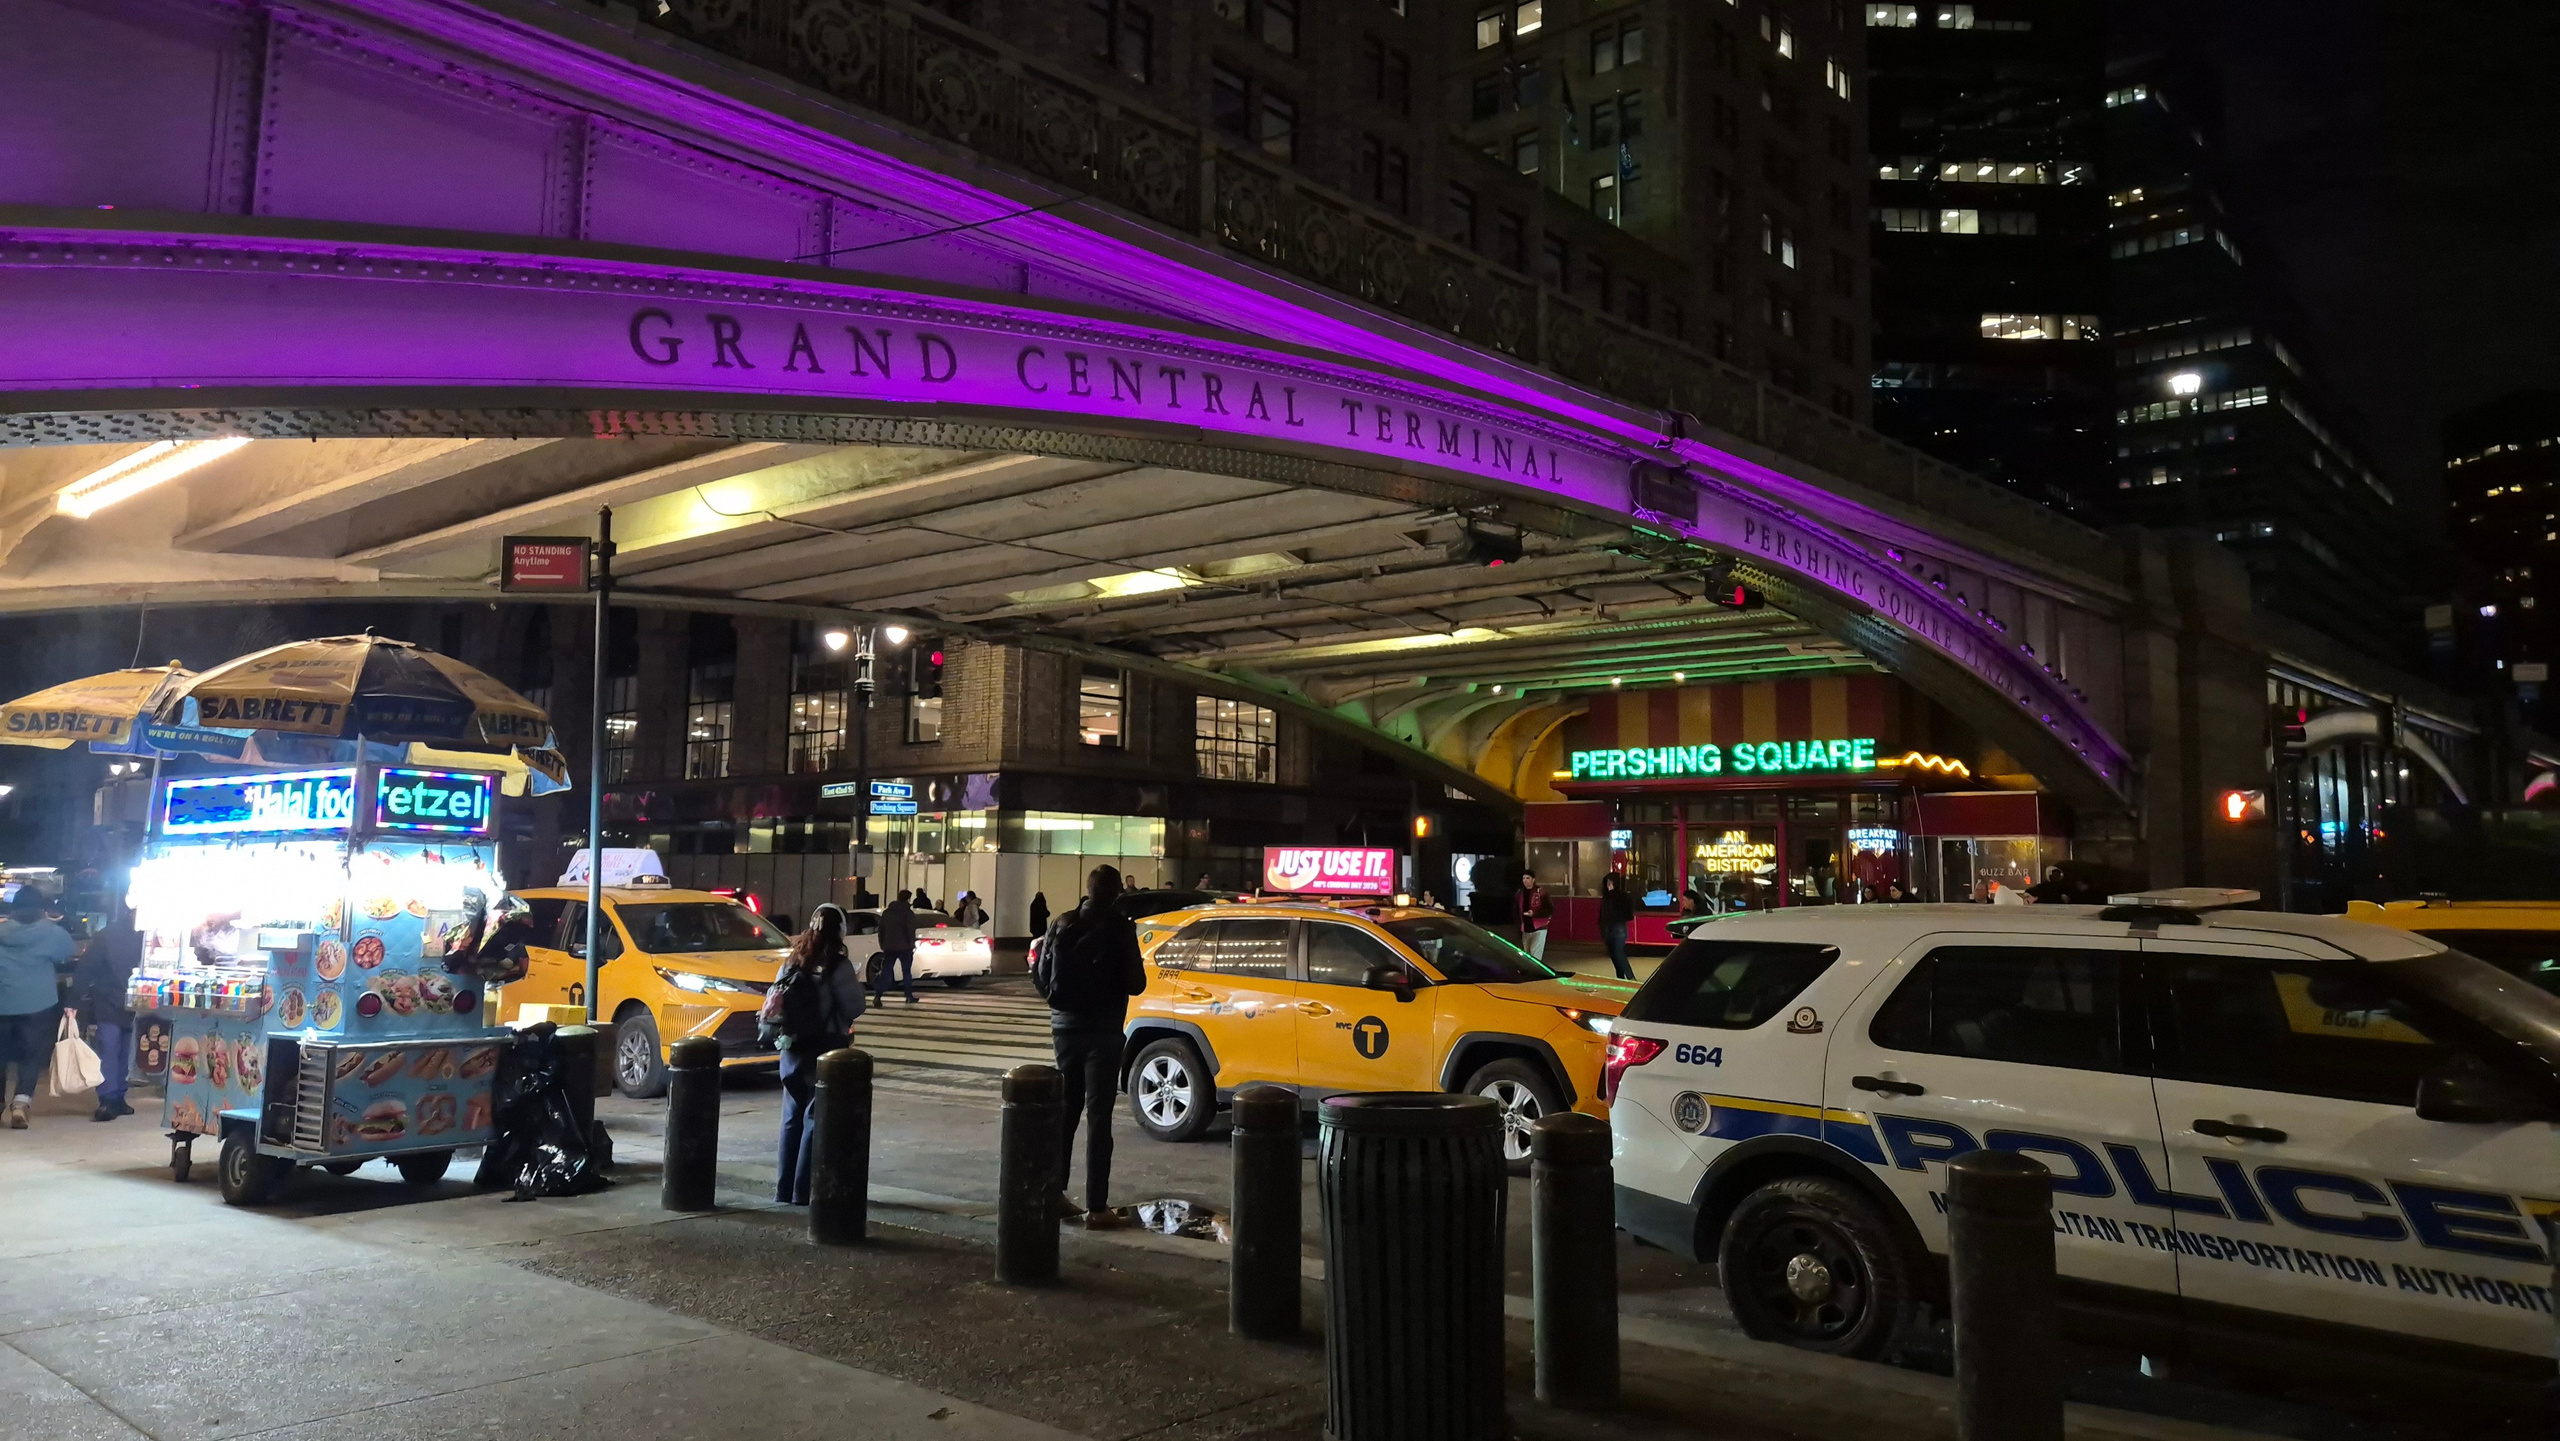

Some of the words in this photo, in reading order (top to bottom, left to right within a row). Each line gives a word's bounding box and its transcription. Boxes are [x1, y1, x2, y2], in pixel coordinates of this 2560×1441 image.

[628, 306, 959, 384] GRAND
[1015, 346, 1305, 427] CENTRAL
[1340, 398, 1564, 484] TERMINAL
[513, 546, 526, 556] NO
[528, 546, 572, 556] STANDING
[513, 556, 550, 567] Anytime
[1744, 518, 1865, 596] PERSHING
[1878, 585, 1952, 649] SQUARE
[200, 697, 340, 726] SABRETT
[6, 712, 127, 736] SABRETT
[478, 712, 547, 738] SABRETT
[148, 729, 177, 740] WE'RE
[178, 731, 192, 741] ON
[193, 732, 200, 742] A
[201, 734, 224, 745] ROLL
[226, 738, 238, 746] !!!
[1570, 743, 1722, 779] PERSHING
[1732, 737, 1876, 773] SQUARE
[823, 787, 835, 796] East
[848, 785, 854, 794] St
[877, 785, 892, 794] Park
[893, 787, 906, 796] Ave
[872, 803, 896, 813] Pershing
[897, 803, 916, 813] Square
[1723, 830, 1746, 844] AN
[1848, 828, 1898, 840] BREAKFAST
[1695, 843, 1776, 859] AMERICAN
[1856, 838, 1895, 850] CENTRAL
[1273, 850, 1323, 875] JUST
[1323, 850, 1363, 877] USE
[1364, 851, 1388, 877] IT.
[1706, 858, 1764, 872] BISTRO
[1980, 867, 2005, 877] BUZZ
[2007, 867, 2030, 877] BAR
[1363, 882, 1379, 891] 2026
[437, 922, 448, 938] A
[1335, 1021, 1352, 1030] NYC
[1361, 1023, 1382, 1055] T
[1675, 1043, 1723, 1068] 664
[1872, 1110, 2553, 1266] POLICE
[1928, 1190, 2125, 1244] MLITAN
[2124, 1220, 2388, 1288] TRANSPORTATION
[2391, 1262, 2553, 1314] AUTHORIT
